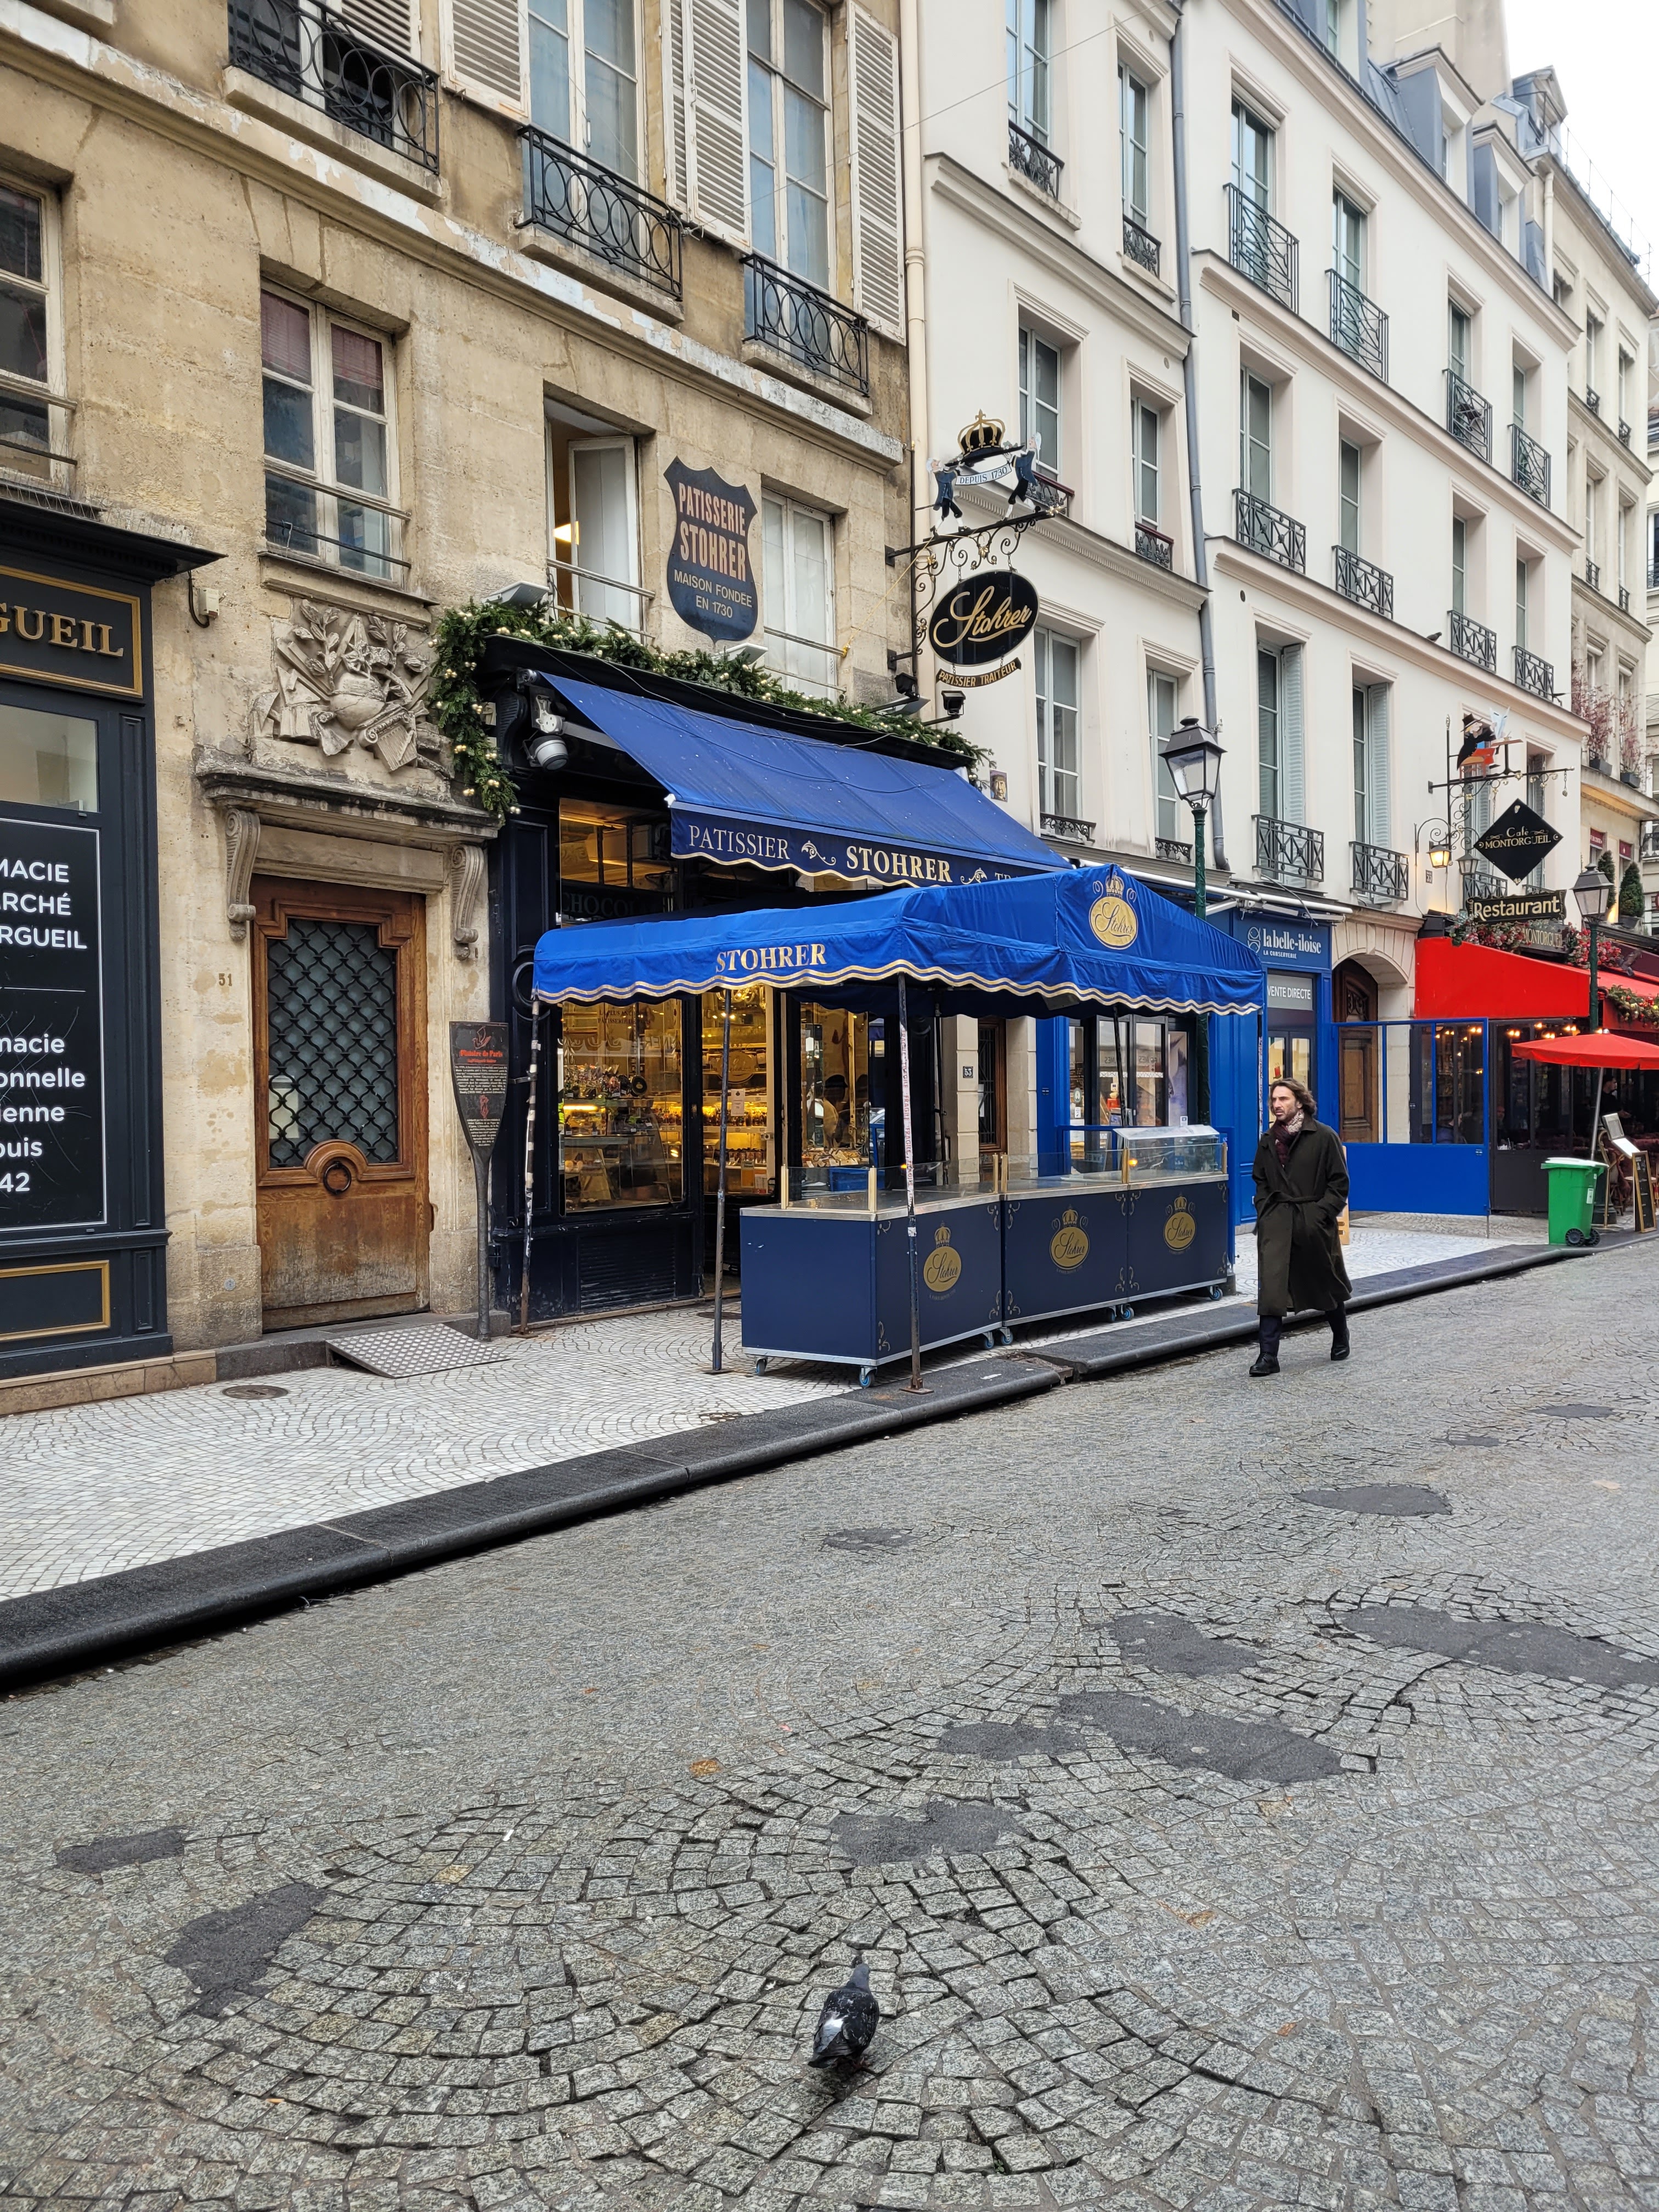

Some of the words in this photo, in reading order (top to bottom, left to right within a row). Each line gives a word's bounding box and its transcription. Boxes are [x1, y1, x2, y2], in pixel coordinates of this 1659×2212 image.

[960, 473, 988, 484] DEPUIS
[991, 466, 1008, 479] 1730
[678, 482, 746, 537] PATISSERIE
[679, 520, 746, 582] STOHRER
[674, 569, 713, 594] MAISON
[696, 595, 709, 611] EN
[712, 601, 733, 618] 1730
[933, 585, 1032, 648] Stohrer
[938, 670, 977, 687] PATISSIER
[980, 661, 1017, 685] TRAITEUR
[1485, 834, 1551, 849] MONTORGUEIL
[1506, 826, 1529, 838] Café
[689, 824, 791, 860] PATISSIER
[846, 845, 953, 883] STOHRER
[0, 892, 71, 916] RCHÉ
[1474, 896, 1560, 921] Restaurant
[1094, 902, 1134, 935] Stohrer
[1272, 929, 1322, 954] belle-iloise
[715, 943, 827, 973] STOHRER
[218, 973, 232, 986] 51
[1267, 985, 1286, 997] VENTE
[1287, 987, 1311, 1000] DIRECTE
[964, 1068, 972, 1076] 53
[0, 1172, 30, 1192] 42
